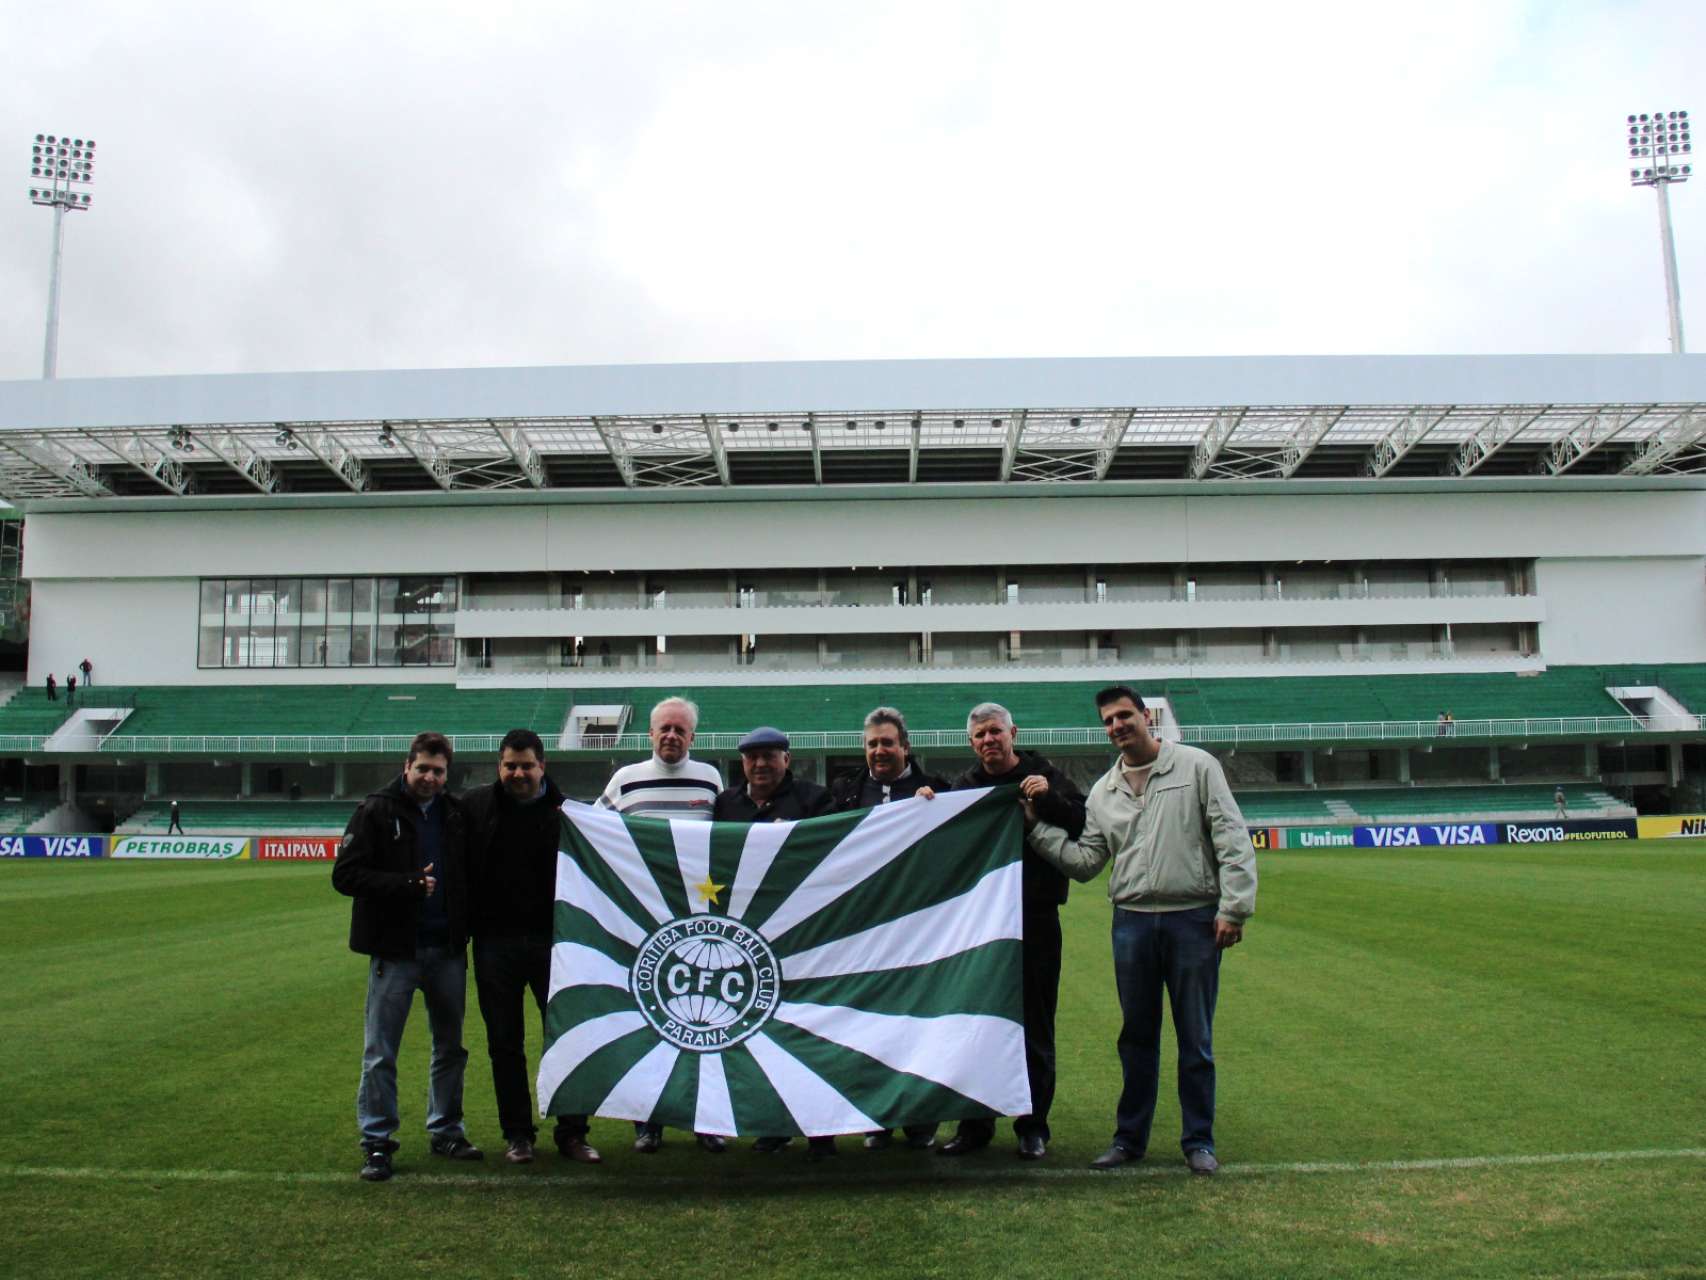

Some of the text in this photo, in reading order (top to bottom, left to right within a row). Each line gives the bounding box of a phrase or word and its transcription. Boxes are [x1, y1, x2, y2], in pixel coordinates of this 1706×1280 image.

[1366, 826, 1421, 846] VISA
[1431, 825, 1486, 845] VISA
[1507, 824, 1628, 843] Rexona #PELOFUTEBOL
[40, 837, 91, 857] VISA
[126, 841, 233, 857] PETROBRAS
[265, 843, 327, 858] ITAIPAVA
[638, 920, 774, 1010] CORITIBA FOOT BALL CLUB
[667, 963, 744, 1003] CFC
[662, 1020, 730, 1046] PARANÁ
